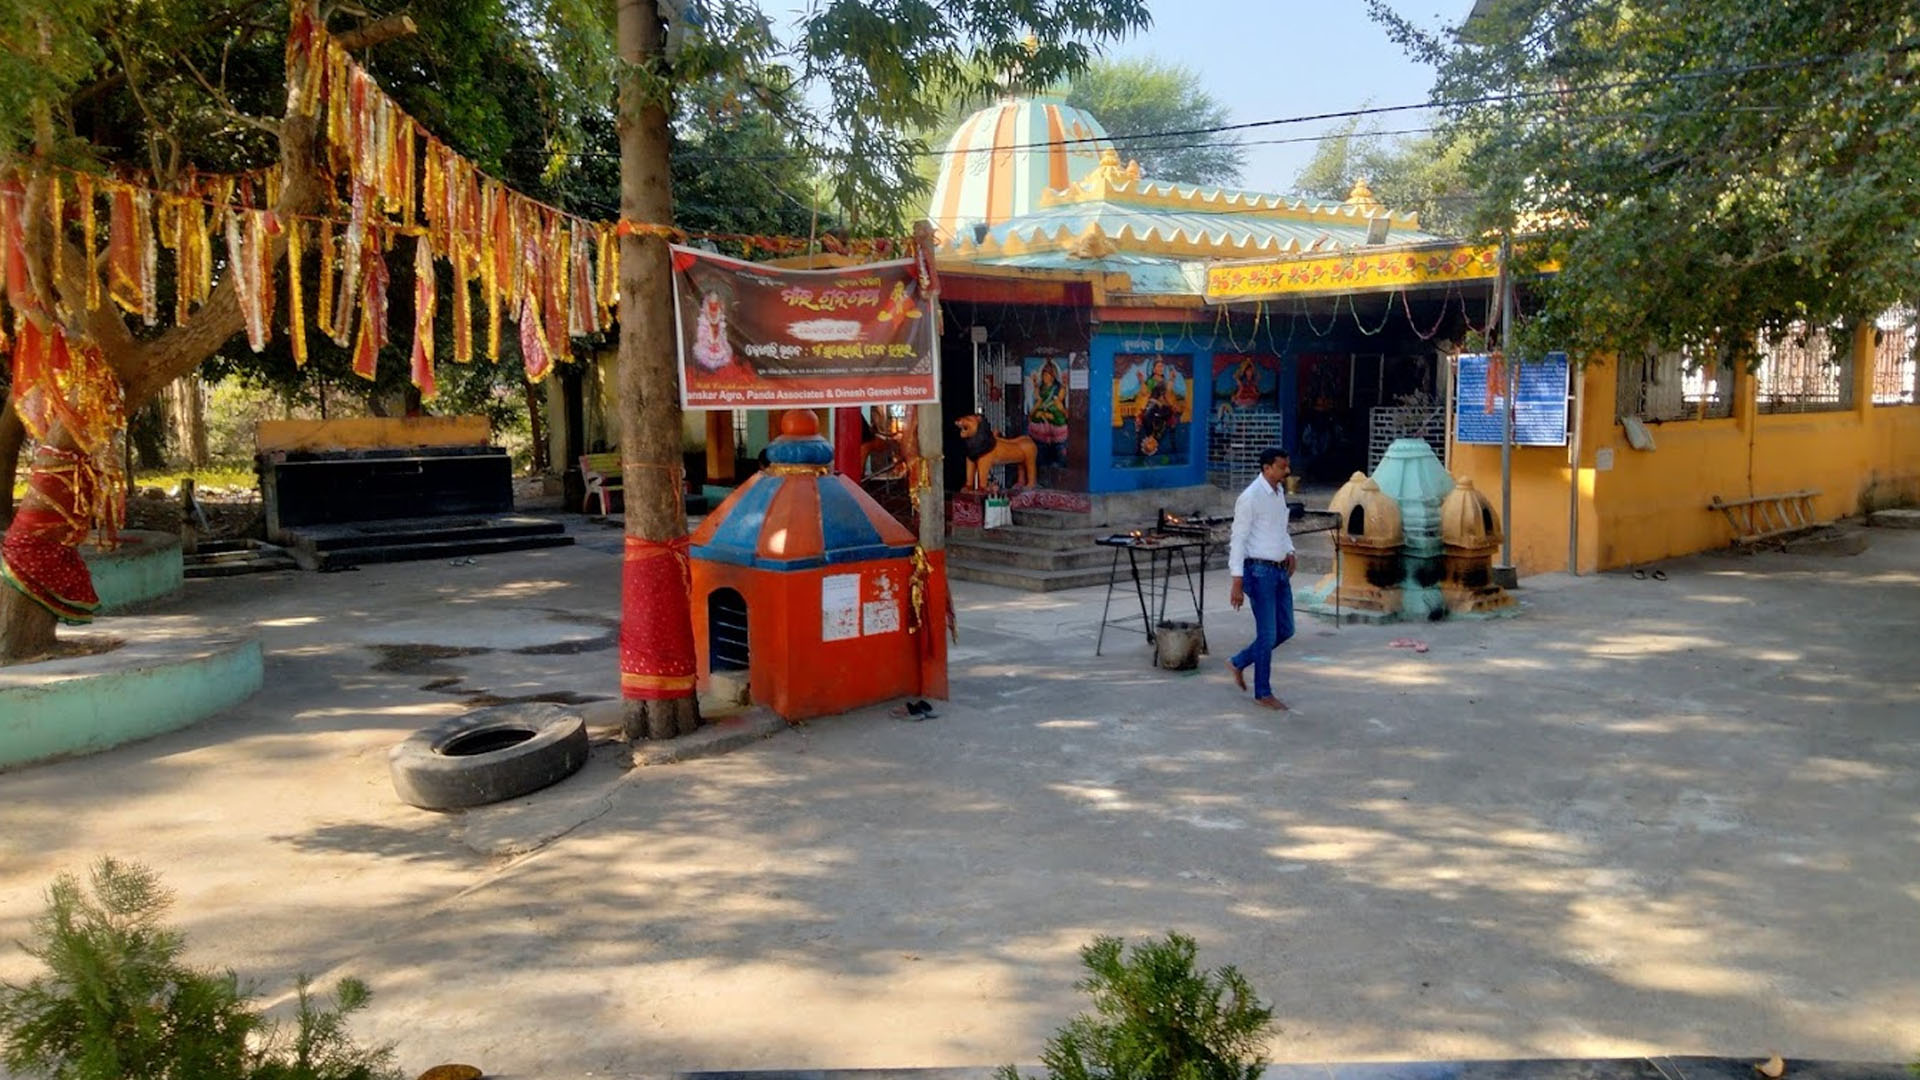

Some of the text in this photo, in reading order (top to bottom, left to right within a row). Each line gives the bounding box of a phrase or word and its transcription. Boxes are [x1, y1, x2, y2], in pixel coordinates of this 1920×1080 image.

[686, 390, 718, 400] anskar
[719, 390, 745, 402] Agro,
[746, 390, 775, 400] Panda
[776, 388, 825, 400] Associates
[826, 389, 834, 398] &
[835, 388, 866, 398] Dinesh
[902, 385, 928, 395] Store
